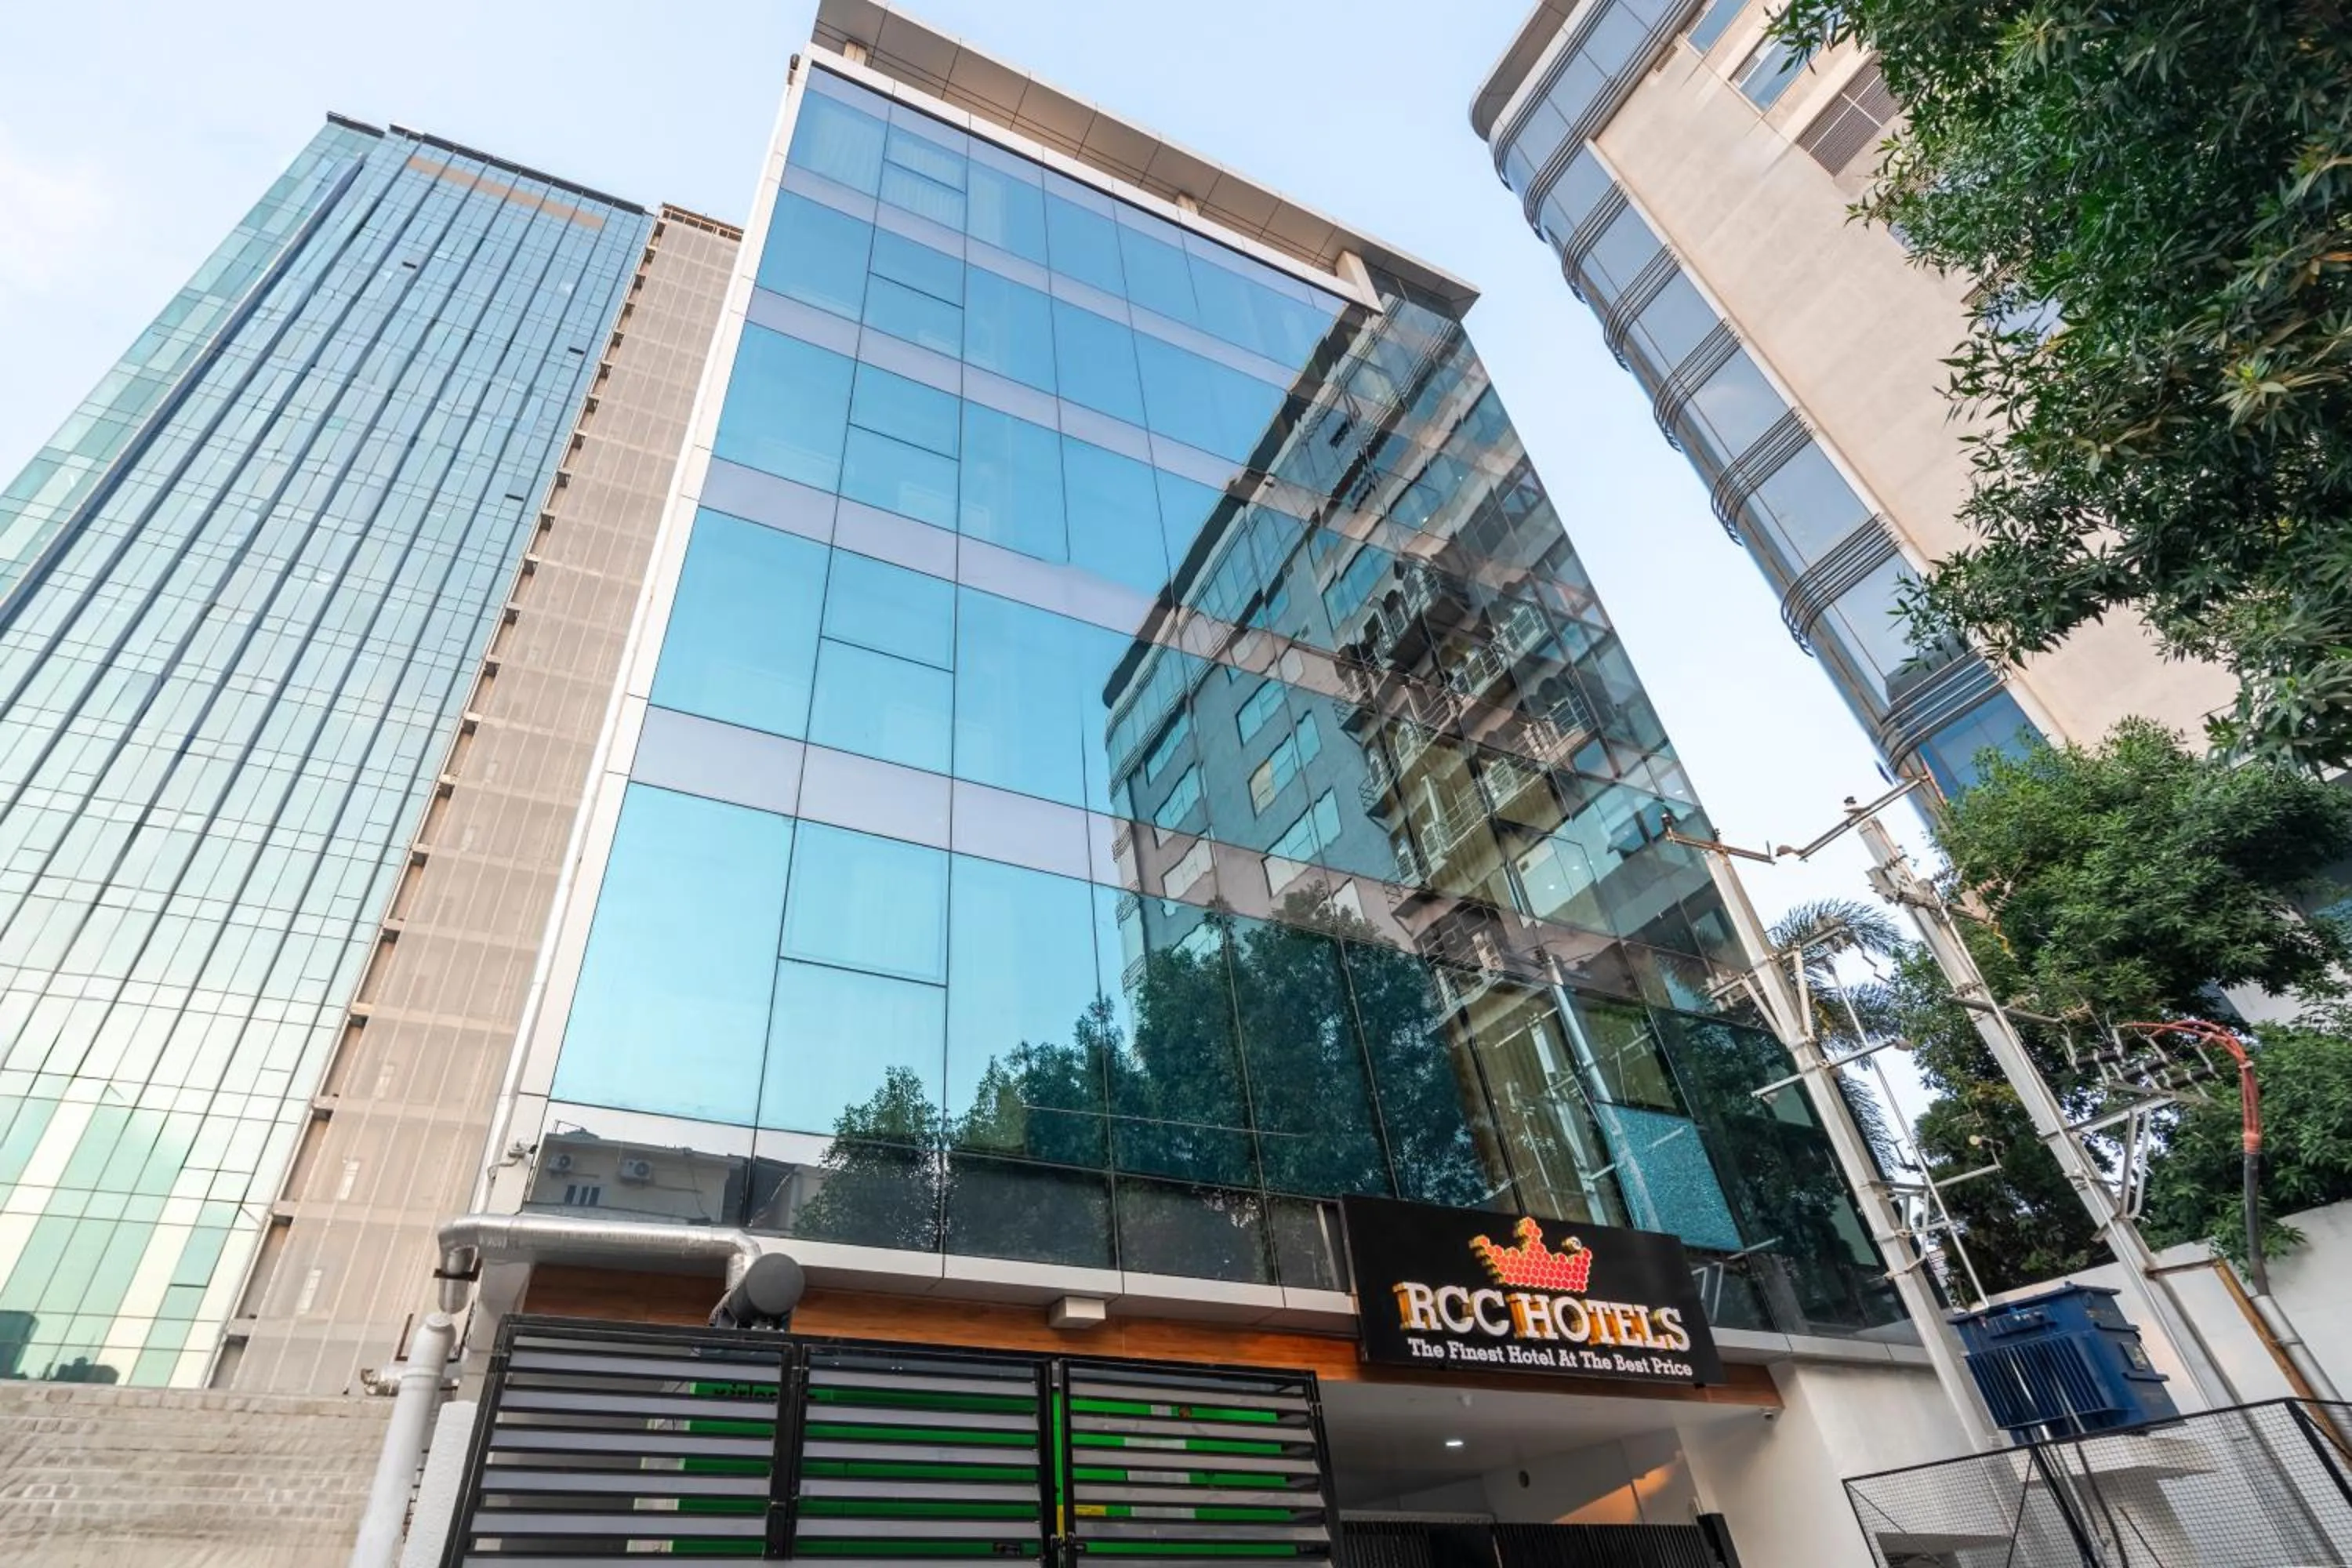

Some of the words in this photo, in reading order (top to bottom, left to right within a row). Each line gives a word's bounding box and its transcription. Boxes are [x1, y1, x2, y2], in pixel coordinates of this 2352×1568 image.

[1395, 1281, 1510, 1338] RCC
[1509, 1292, 1690, 1351] HOTELS
[1407, 1338, 1444, 1359] The
[1449, 1341, 1504, 1363] Finest
[1508, 1345, 1555, 1367] Hotel
[1559, 1348, 1578, 1368] At
[1580, 1350, 1612, 1370] The
[1616, 1352, 1650, 1374] Best
[1652, 1355, 1693, 1377] Price
